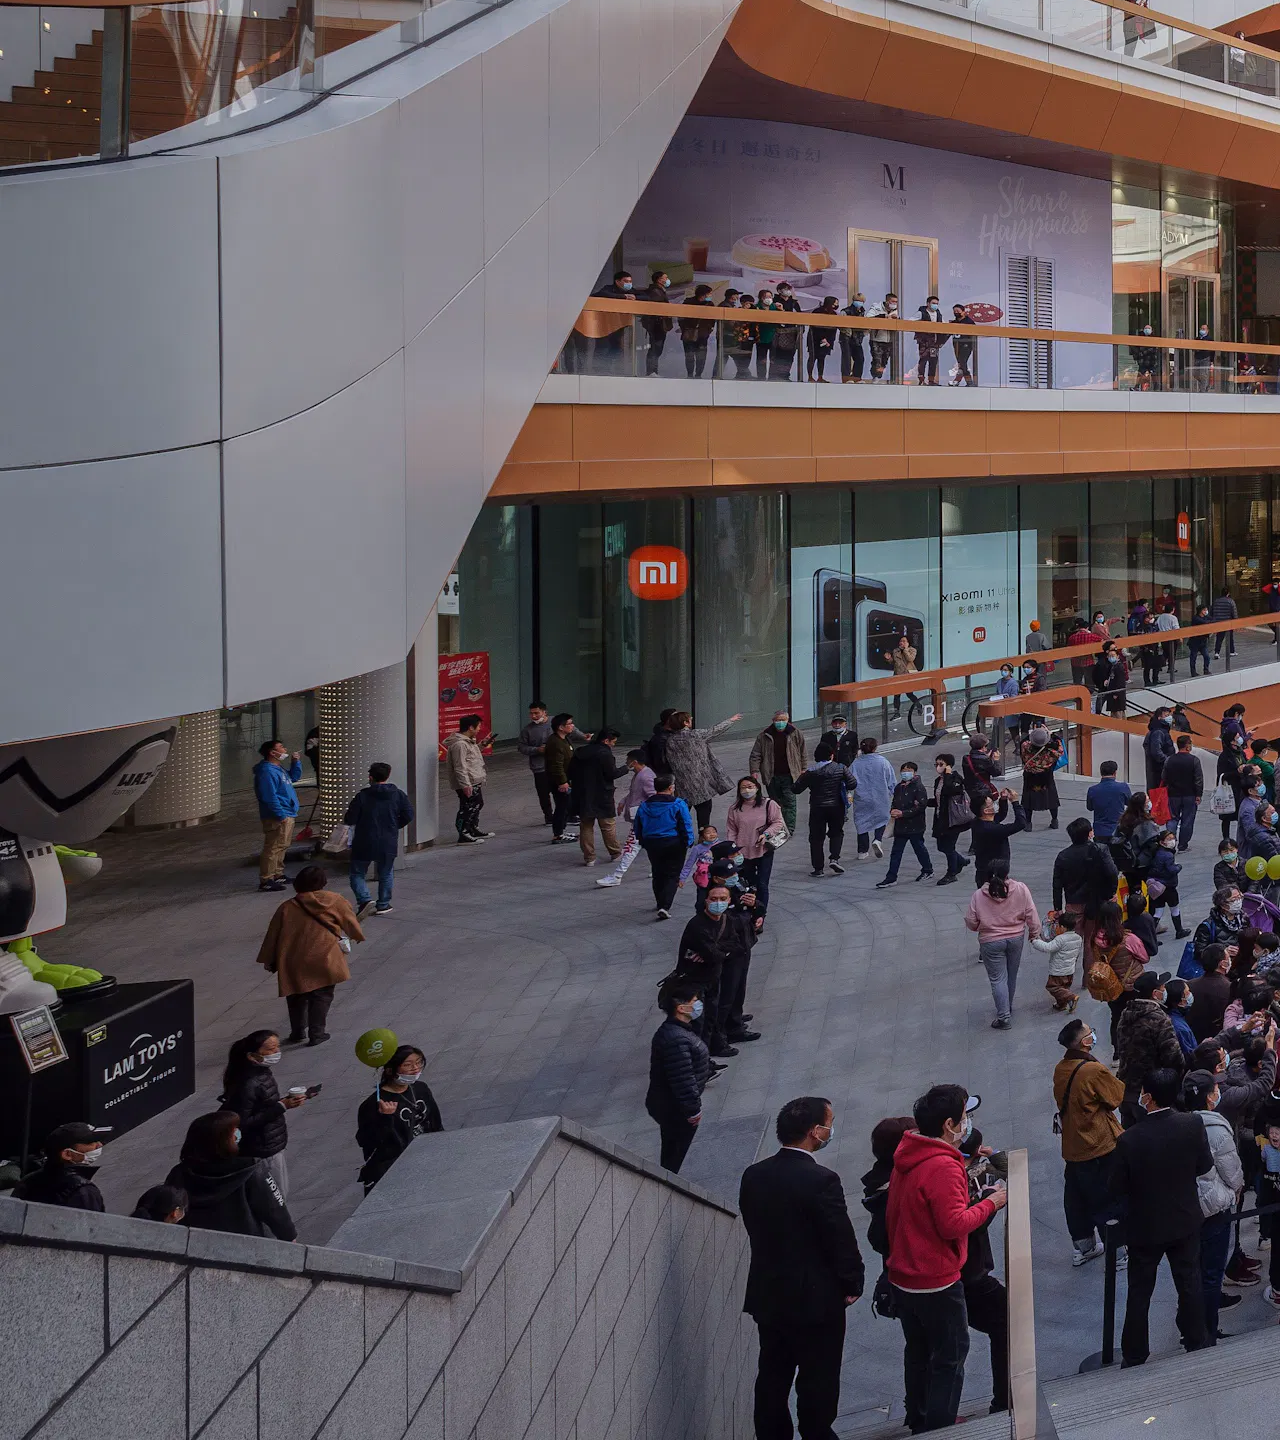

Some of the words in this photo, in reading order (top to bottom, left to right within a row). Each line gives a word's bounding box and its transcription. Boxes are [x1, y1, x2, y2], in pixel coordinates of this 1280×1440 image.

[880, 163, 907, 191] M
[998, 176, 1070, 220] Share
[978, 208, 1092, 259] Happiness
[987, 588, 995, 597] 11
[998, 587, 1016, 596] Ultra
[958, 601, 1000, 615] 影像新物种
[923, 701, 947, 726] B1
[104, 1055, 135, 1085] LAM
[104, 1081, 149, 1109] COLLECTIBLE
[152, 1066, 177, 1083] FIGURE
